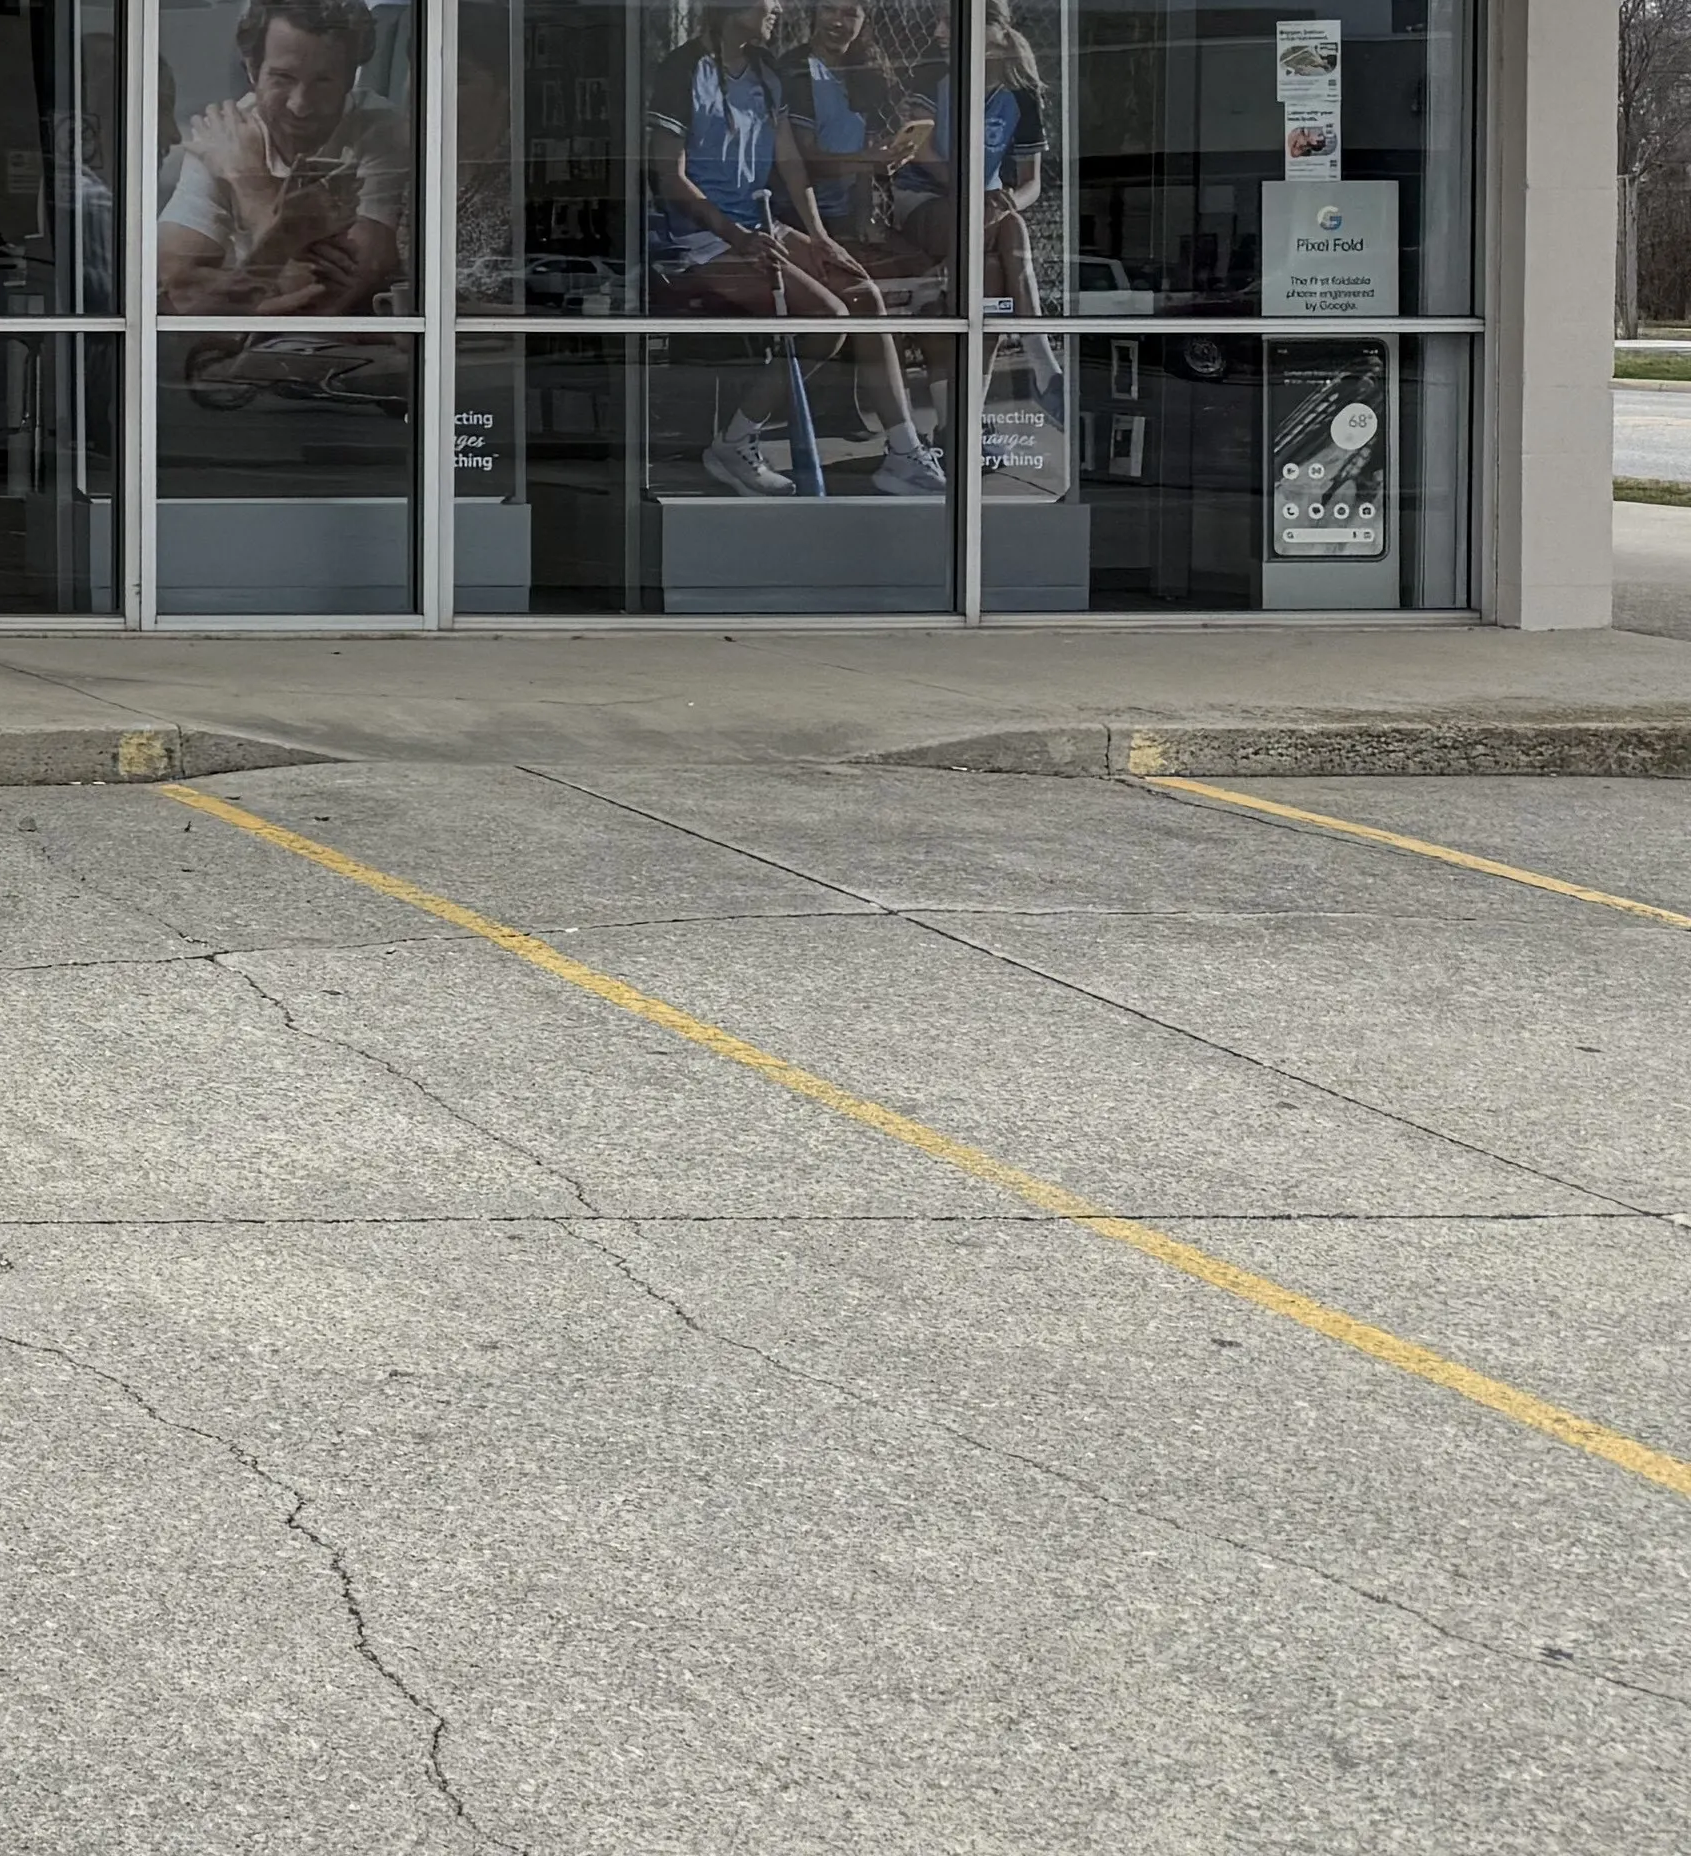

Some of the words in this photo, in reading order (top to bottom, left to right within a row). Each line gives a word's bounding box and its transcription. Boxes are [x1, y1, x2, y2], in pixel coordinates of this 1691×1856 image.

[1297, 238, 1329, 252] Pixel
[1333, 238, 1364, 252] Fold
[1291, 276, 1307, 285] The
[1331, 276, 1371, 285] foldable
[1305, 302, 1317, 312] by
